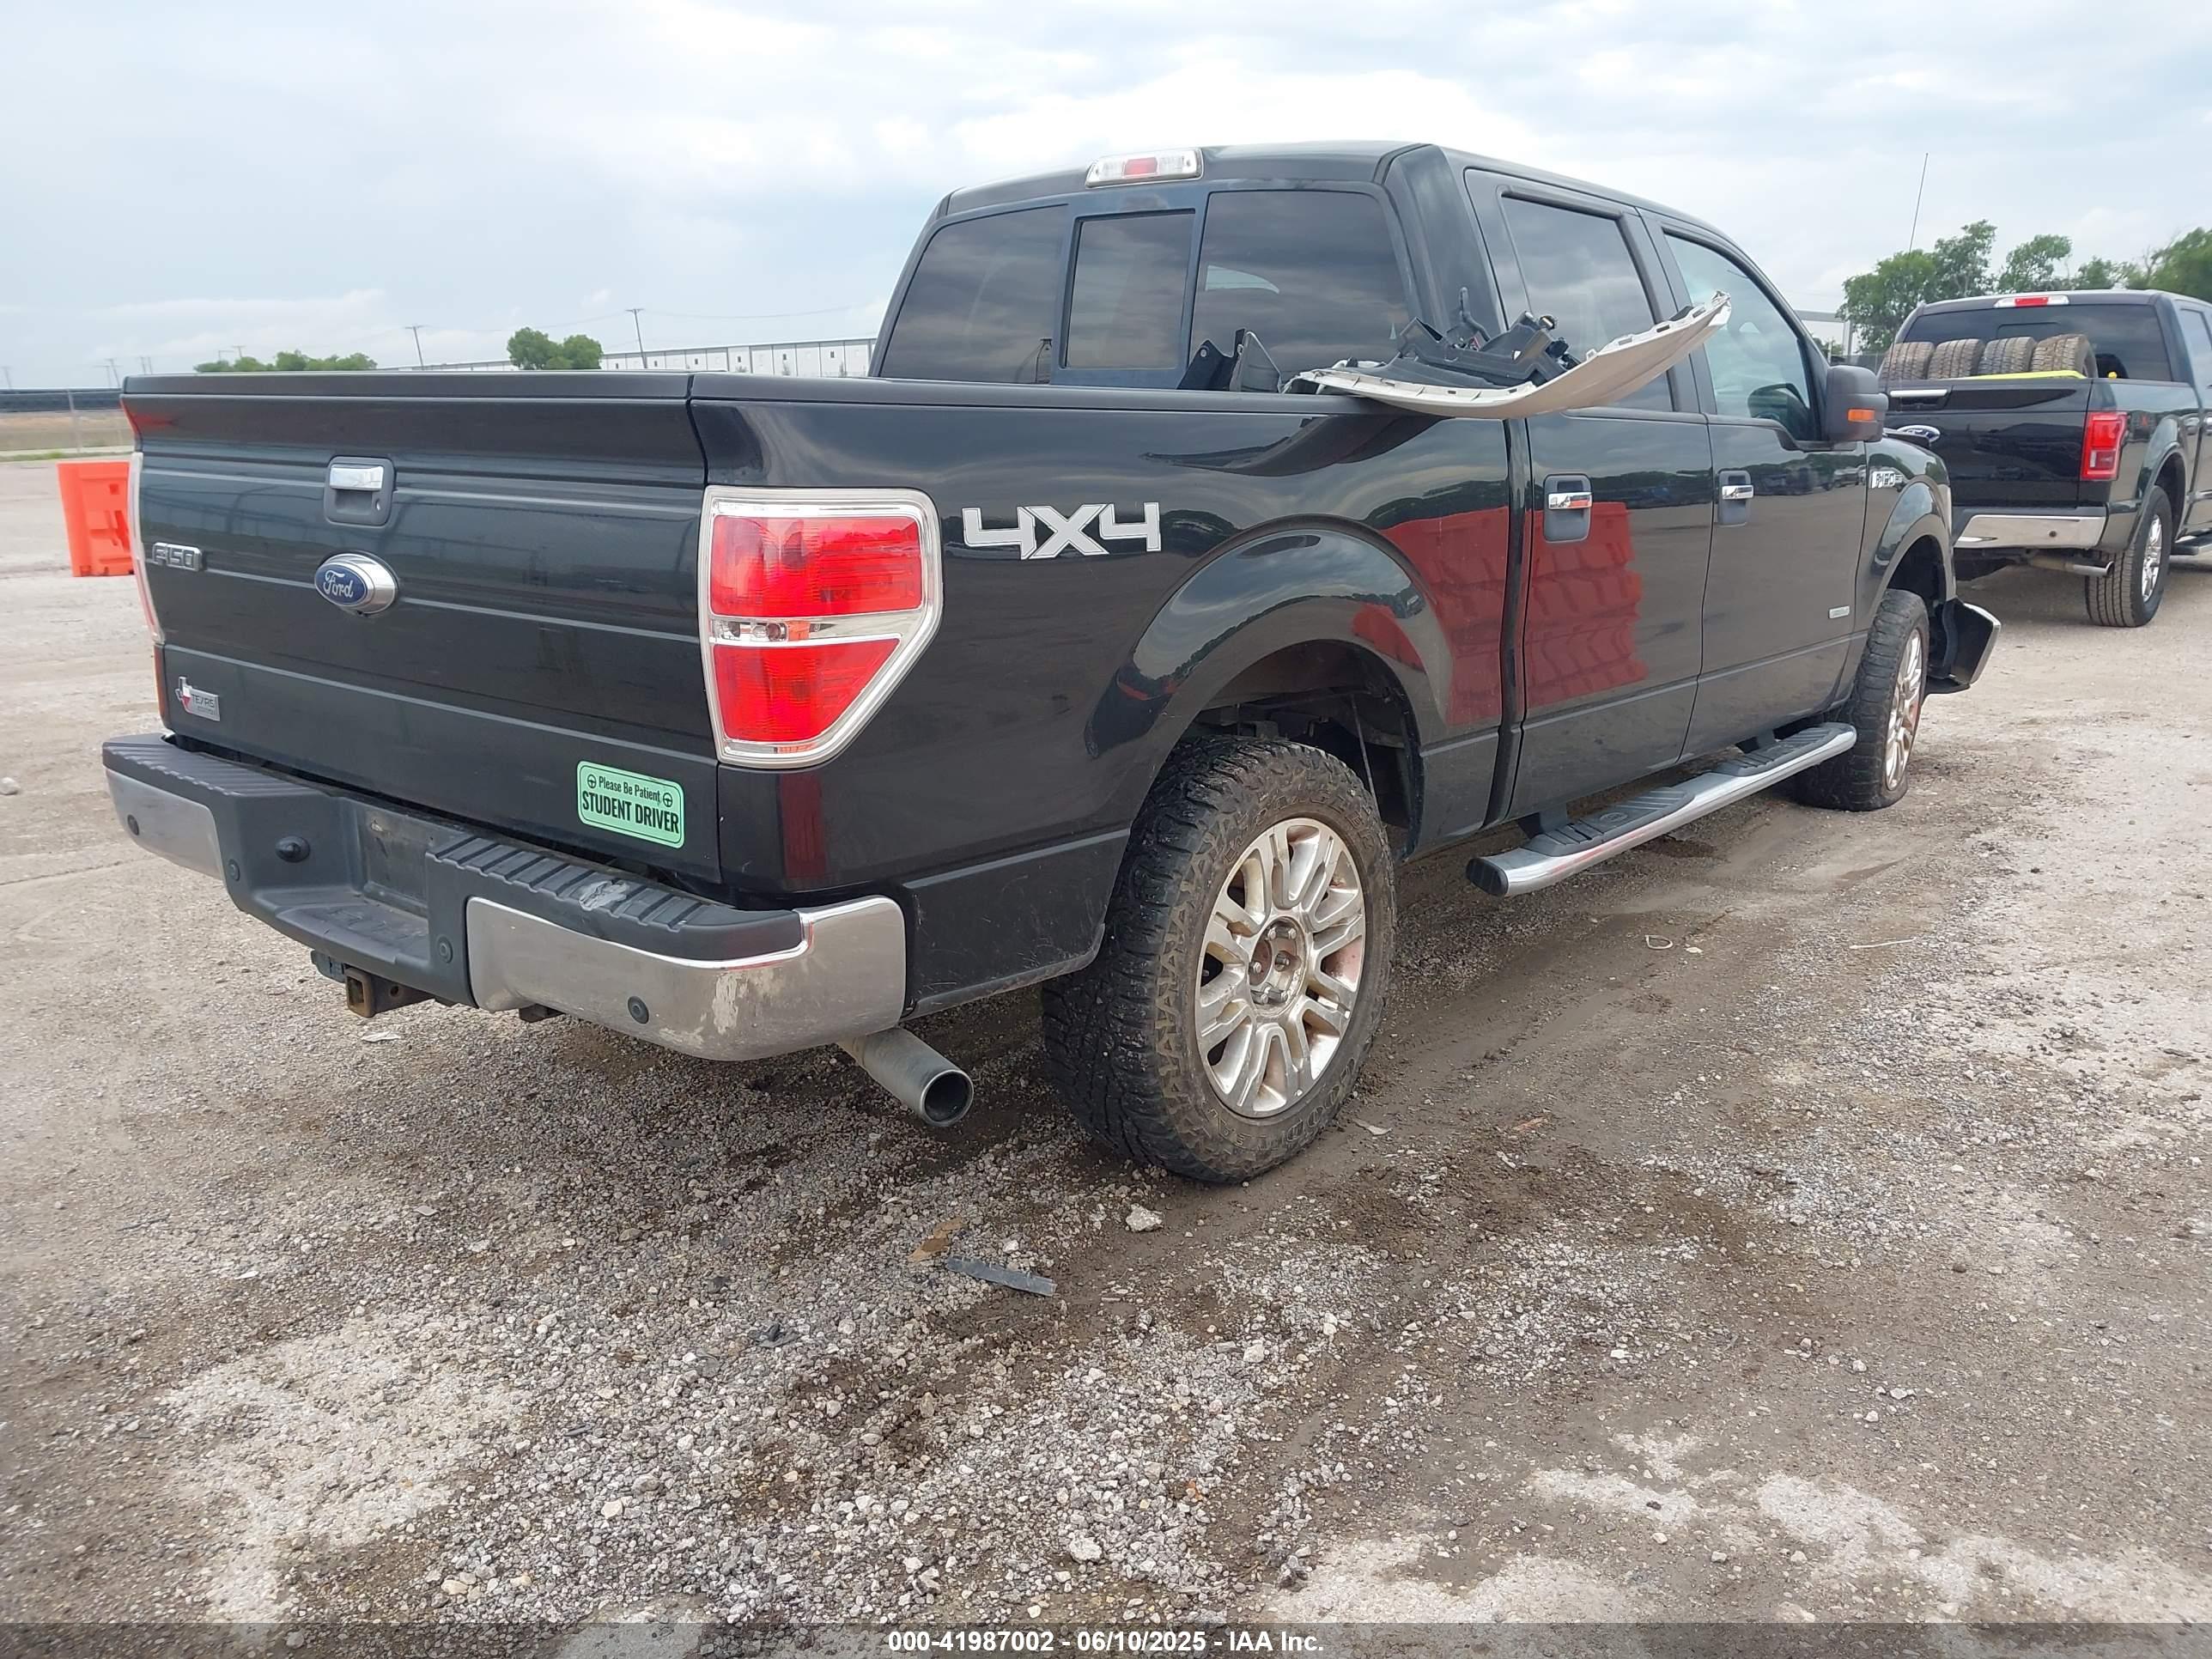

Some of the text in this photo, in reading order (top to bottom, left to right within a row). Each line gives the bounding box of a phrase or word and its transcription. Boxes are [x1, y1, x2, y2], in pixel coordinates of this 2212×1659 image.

[962, 501, 1162, 560] 4X4
[323, 570, 354, 599] Ford
[599, 775, 660, 802] Please Be Patient
[582, 790, 679, 834] STUDENT DRIVER
